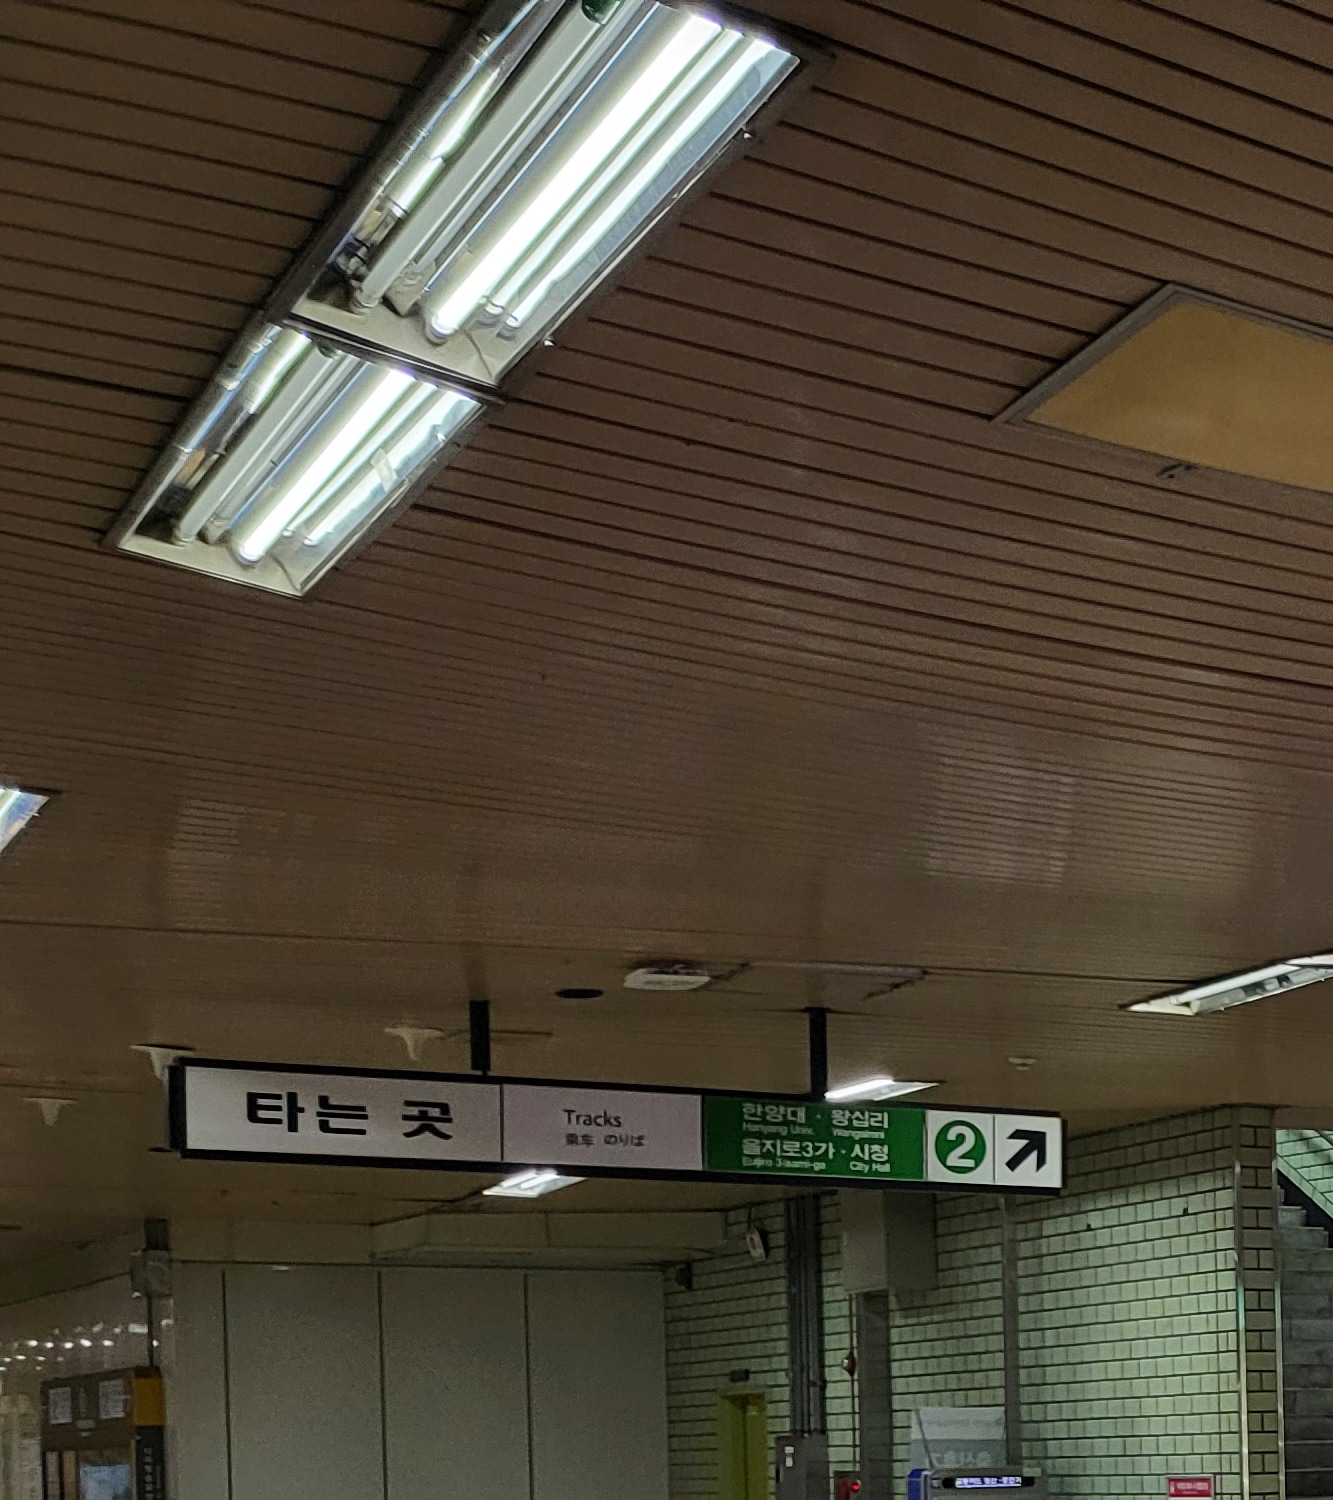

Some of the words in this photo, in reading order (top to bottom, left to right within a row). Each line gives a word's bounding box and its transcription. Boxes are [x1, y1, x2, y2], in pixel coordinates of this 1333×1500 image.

[245, 1090, 370, 1137] 타는
[401, 1098, 454, 1141] 곳
[563, 1109, 622, 1128] Tracks
[742, 1103, 806, 1123] 한양대
[831, 1109, 889, 1129] 왕십리
[742, 1138, 836, 1159] 을지로3가
[850, 1143, 889, 1161] 시청
[945, 1125, 976, 1168] 2
